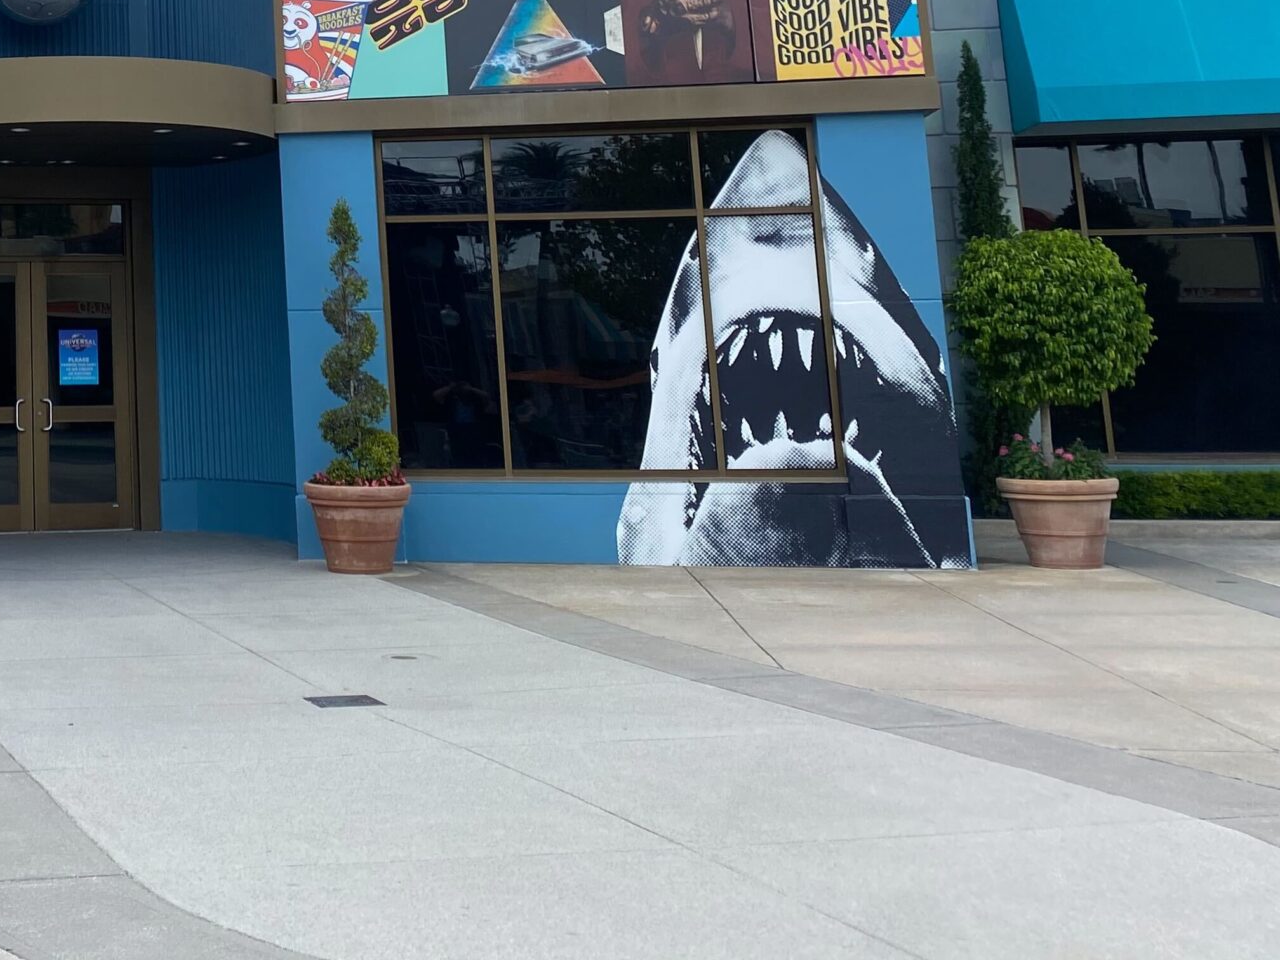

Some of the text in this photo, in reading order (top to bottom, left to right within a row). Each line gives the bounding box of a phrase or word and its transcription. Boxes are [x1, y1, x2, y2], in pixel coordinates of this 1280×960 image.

[317, 4, 365, 24] BREAKFAST
[320, 14, 363, 32] NOODLES
[775, 19, 833, 50] GOOD
[777, 44, 835, 66] GOOD
